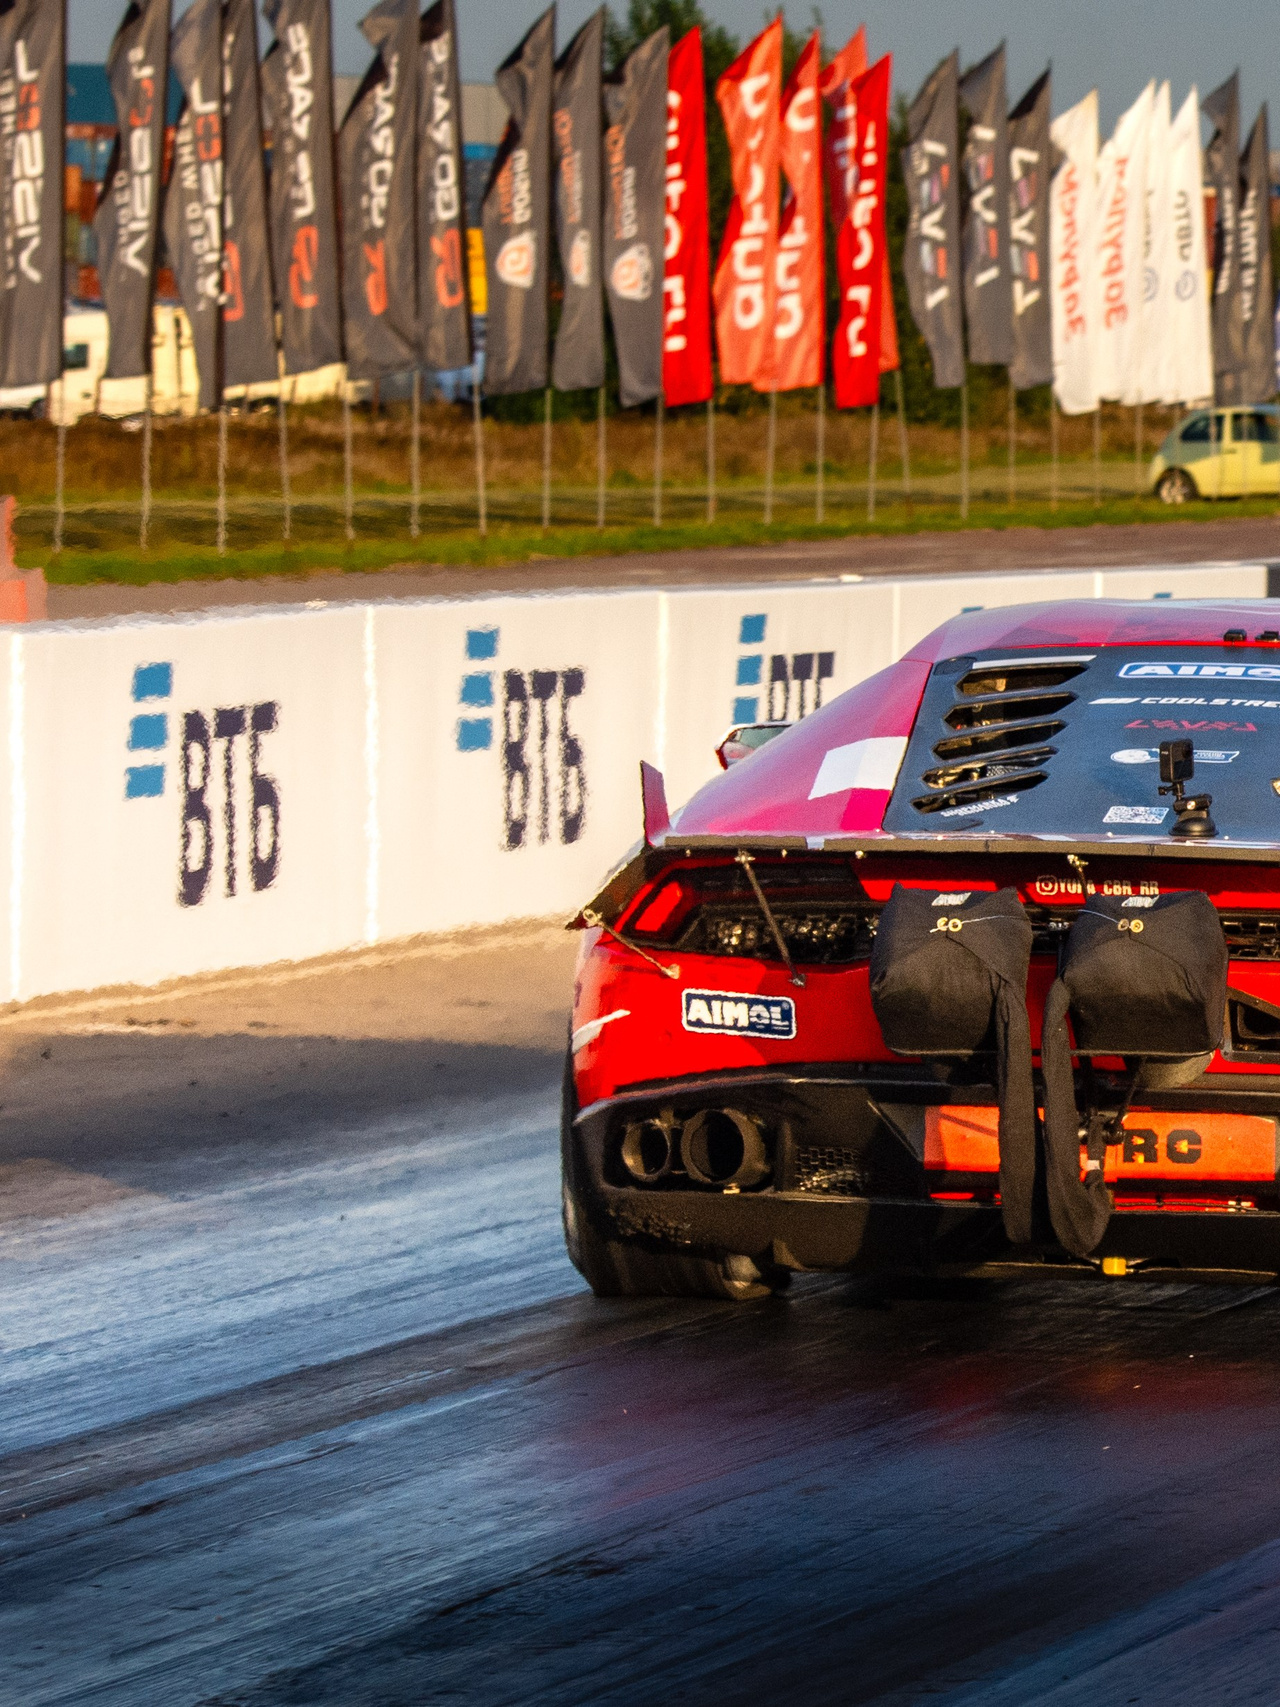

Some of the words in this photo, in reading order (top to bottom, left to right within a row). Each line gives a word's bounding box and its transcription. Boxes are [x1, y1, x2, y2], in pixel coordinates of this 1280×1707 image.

[178, 700, 280, 906] ВТБ
[501, 666, 588, 851] ВТБ
[687, 999, 790, 1030] AIMOL
